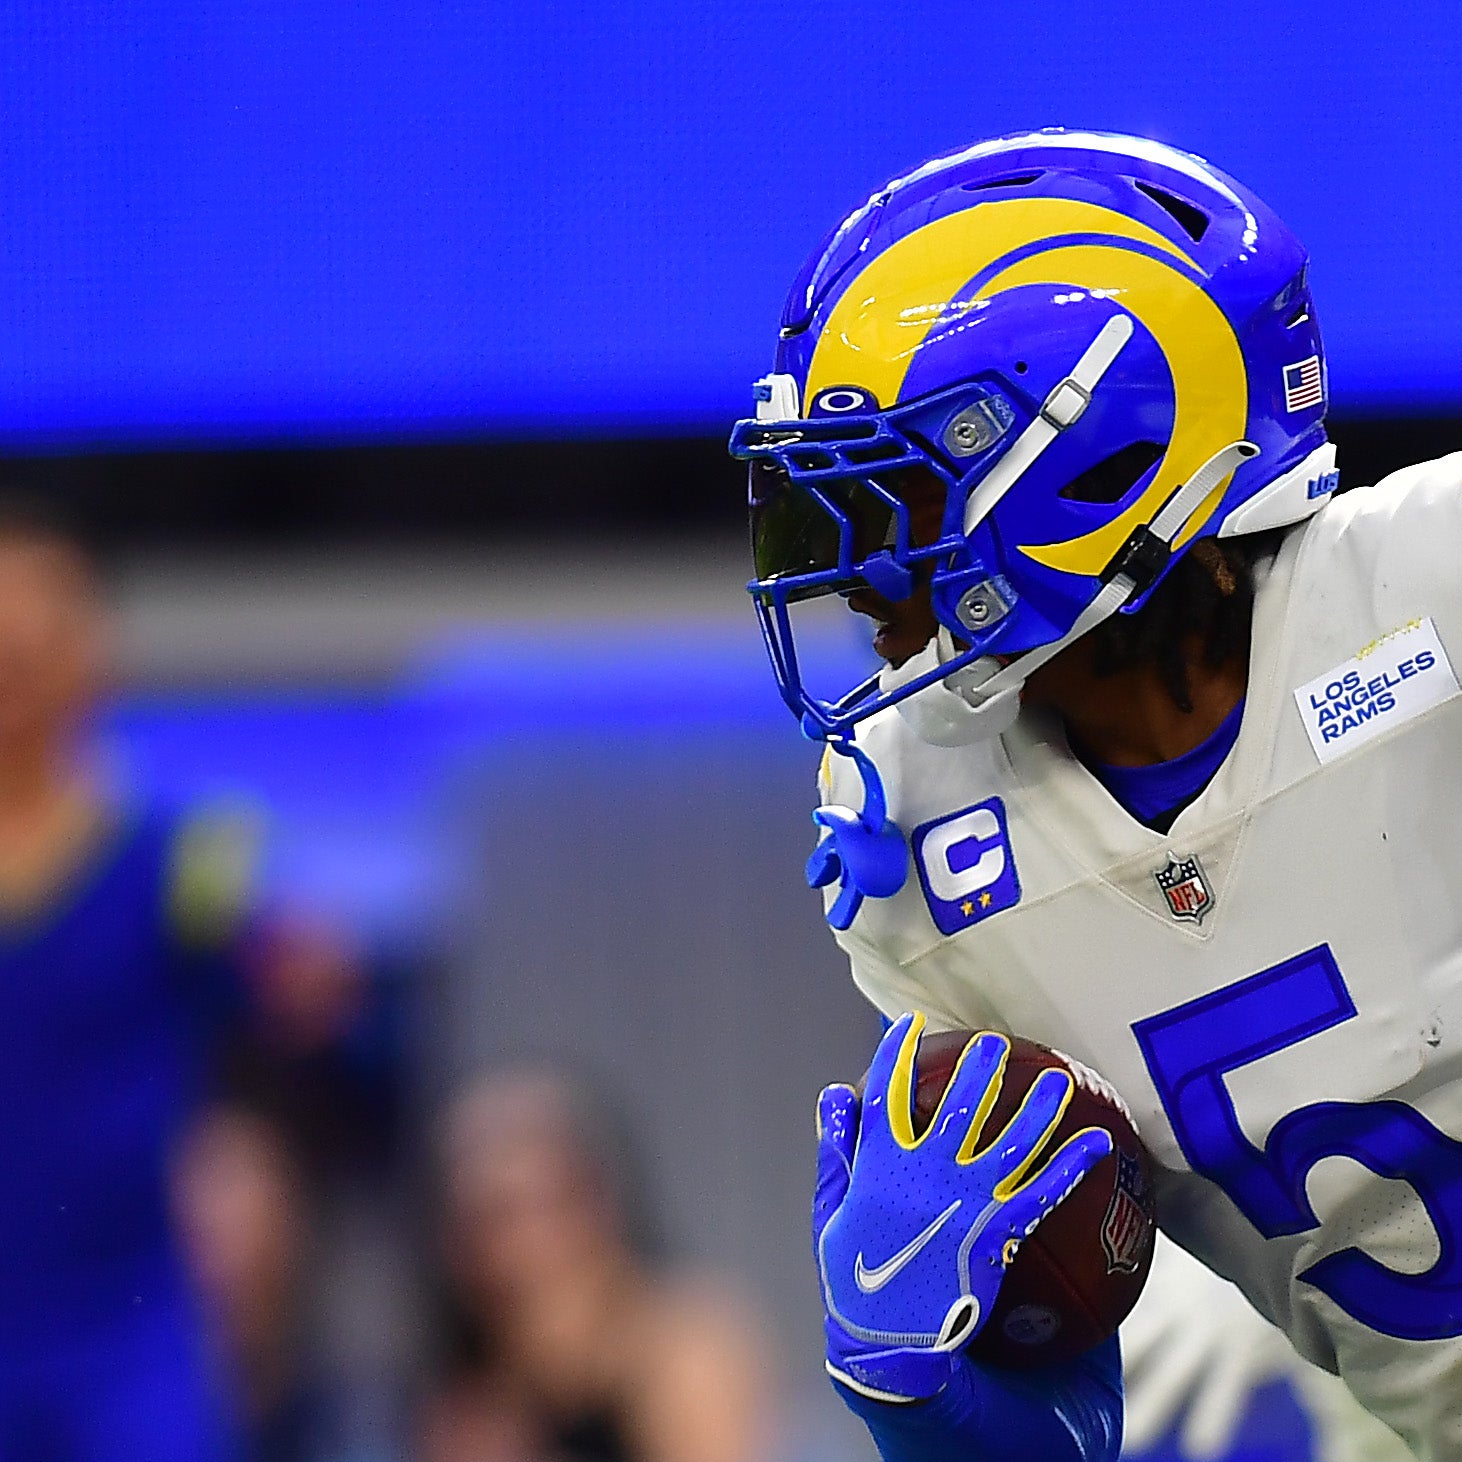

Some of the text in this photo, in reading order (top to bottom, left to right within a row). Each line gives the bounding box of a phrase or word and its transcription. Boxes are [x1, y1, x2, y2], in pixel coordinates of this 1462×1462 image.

[1310, 671, 1360, 709] LOS
[1318, 651, 1435, 727] ANGELES
[1321, 691, 1396, 743] RAMS
[921, 808, 1004, 901] C
[1167, 881, 1206, 911] NFL
